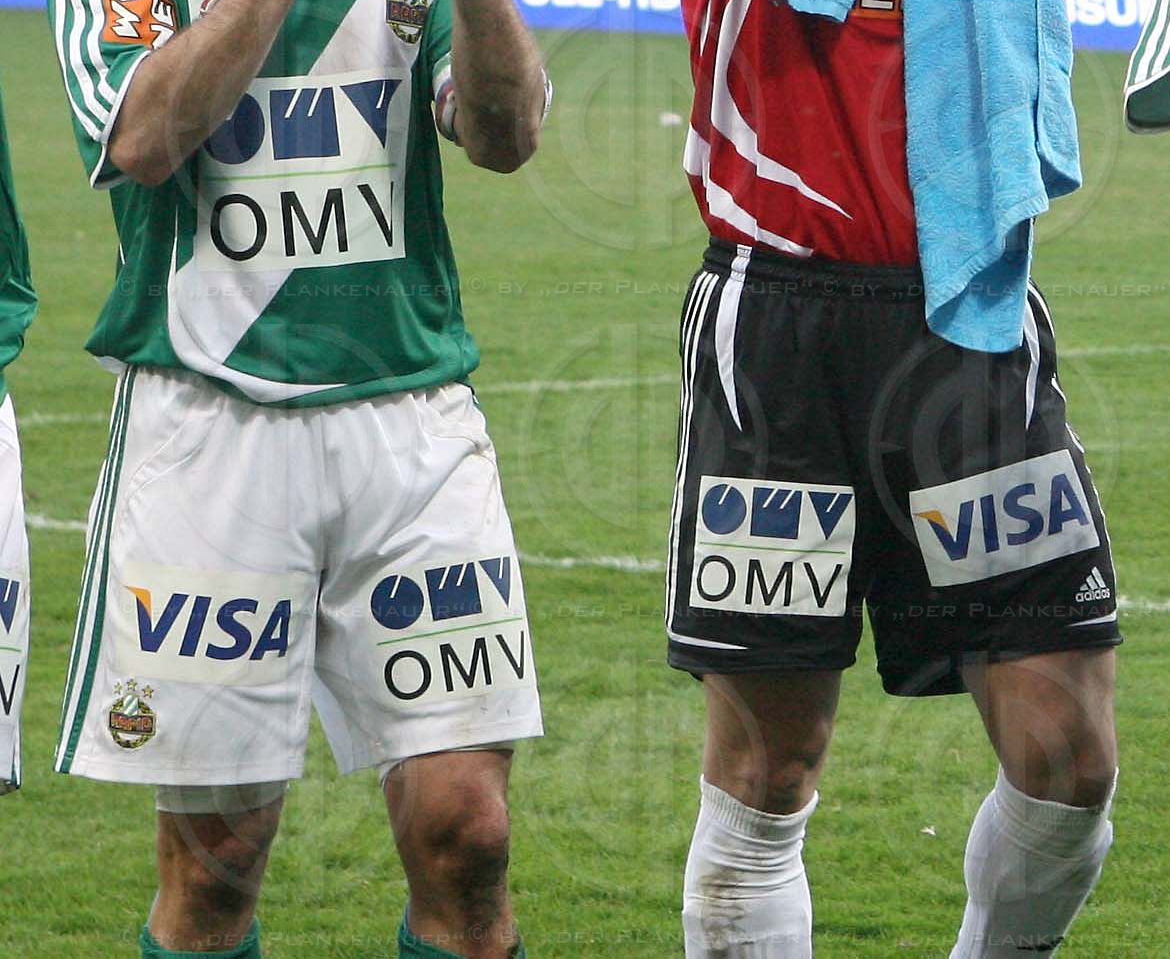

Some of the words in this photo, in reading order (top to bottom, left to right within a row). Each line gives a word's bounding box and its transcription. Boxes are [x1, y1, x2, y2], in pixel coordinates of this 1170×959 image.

[210, 181, 394, 262] OMV
[912, 473, 1089, 561] VISA
[697, 555, 843, 608] OMV
[1075, 589, 1111, 603] adidas
[125, 586, 291, 661] VISA
[384, 631, 525, 700] OMV
